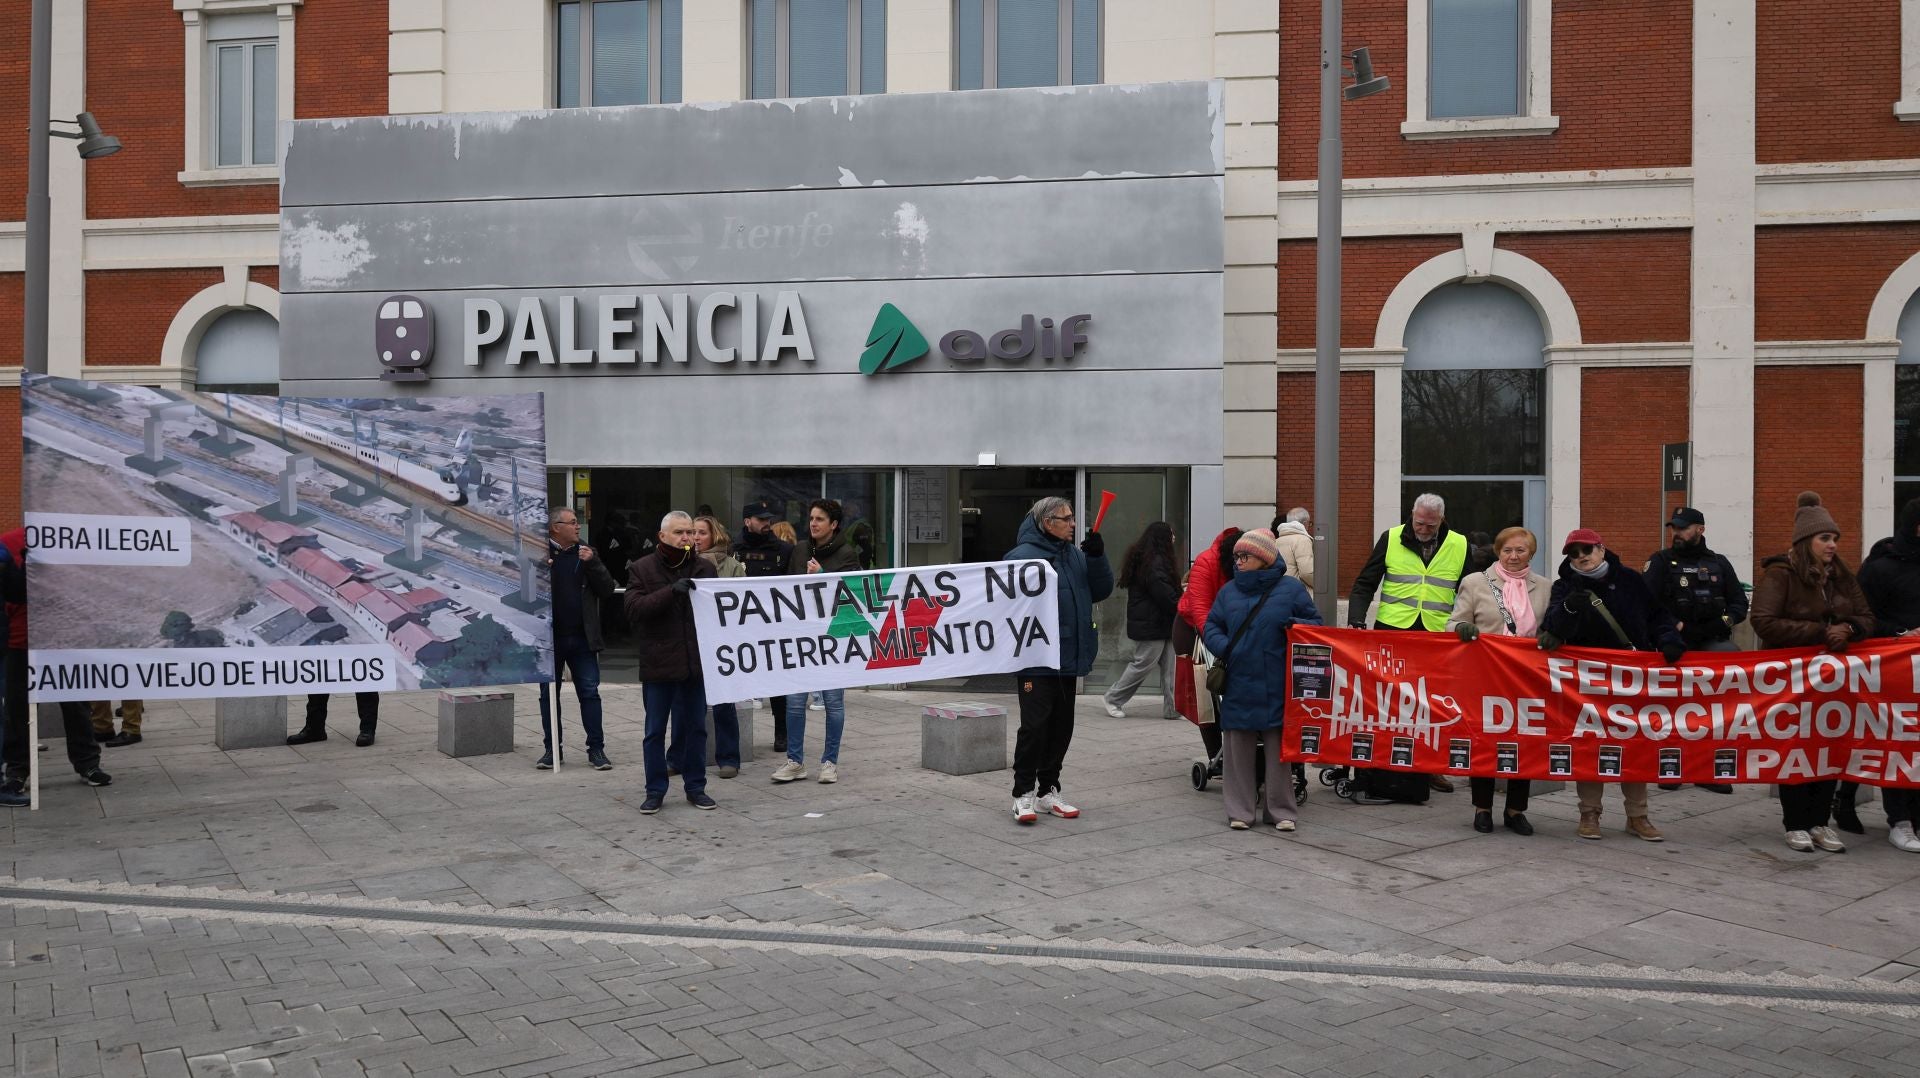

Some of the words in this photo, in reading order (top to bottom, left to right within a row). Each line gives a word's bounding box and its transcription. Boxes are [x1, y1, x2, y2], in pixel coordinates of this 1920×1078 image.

[463, 291, 815, 367] PALENCIA
[940, 313, 1092, 362] adif
[25, 525, 91, 550] OBRA
[98, 527, 180, 552] ILEGAL
[714, 571, 961, 627] PANTALLAS
[984, 561, 1048, 604] NO
[716, 619, 995, 677] SOTERRAMIENTO
[1006, 615, 1051, 658] YA
[136, 661, 216, 688] VIEJO
[223, 661, 254, 686] DE
[261, 658, 385, 684] HUSILLOS
[1482, 696, 1548, 735] DE
[1573, 701, 1920, 741] ASOCIACIONE
[1746, 747, 1920, 783] PALEN
